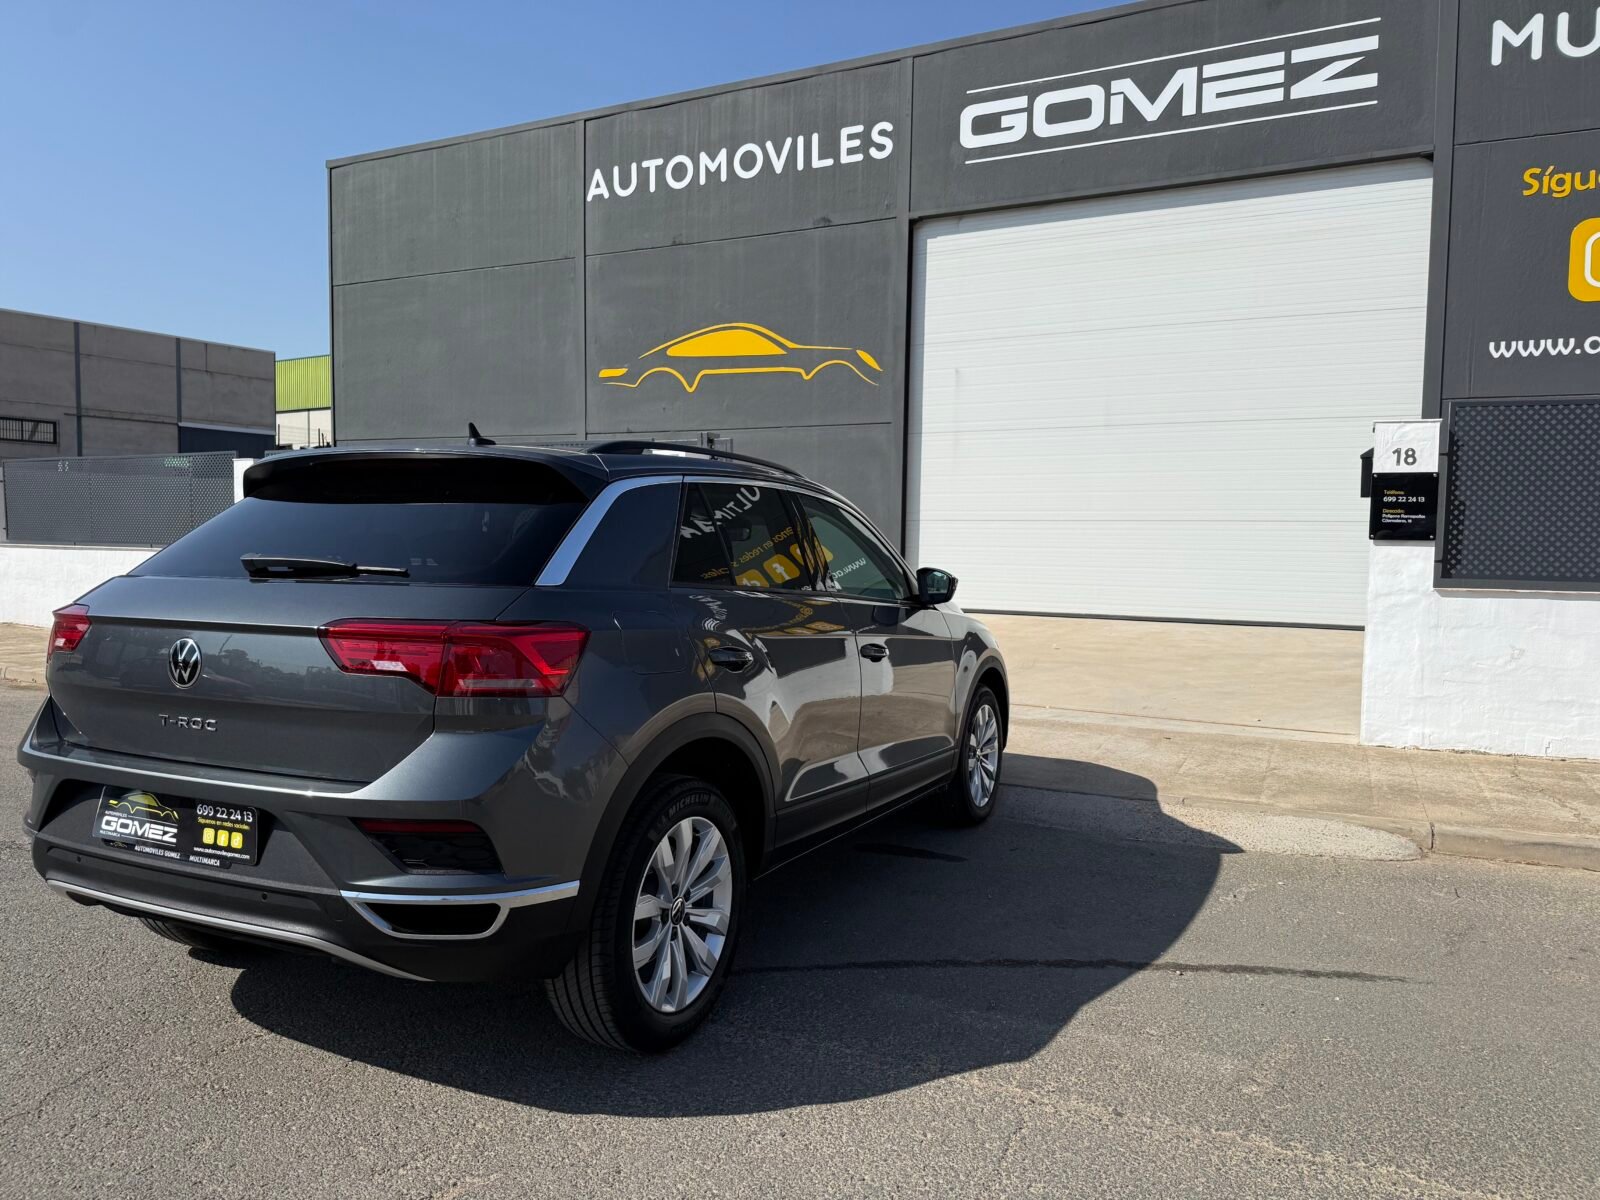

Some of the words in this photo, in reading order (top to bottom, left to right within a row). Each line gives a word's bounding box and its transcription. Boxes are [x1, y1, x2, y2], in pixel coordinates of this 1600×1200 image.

[960, 35, 1379, 149] GOMEZ
[586, 121, 894, 202] AUTOMOVILES
[1522, 165, 1600, 198] Sígu
[1391, 447, 1418, 467] 18
[158, 713, 218, 732] T-ROC
[196, 803, 214, 817] 699
[215, 807, 228, 819] 22
[229, 809, 242, 821] 24
[243, 811, 253, 823] 13
[101, 815, 178, 843] GOMEZ
[134, 845, 164, 857] AUTOMOVILES
[164, 849, 181, 860] GOMEZ
[188, 854, 220, 867] MULTIMARCA
